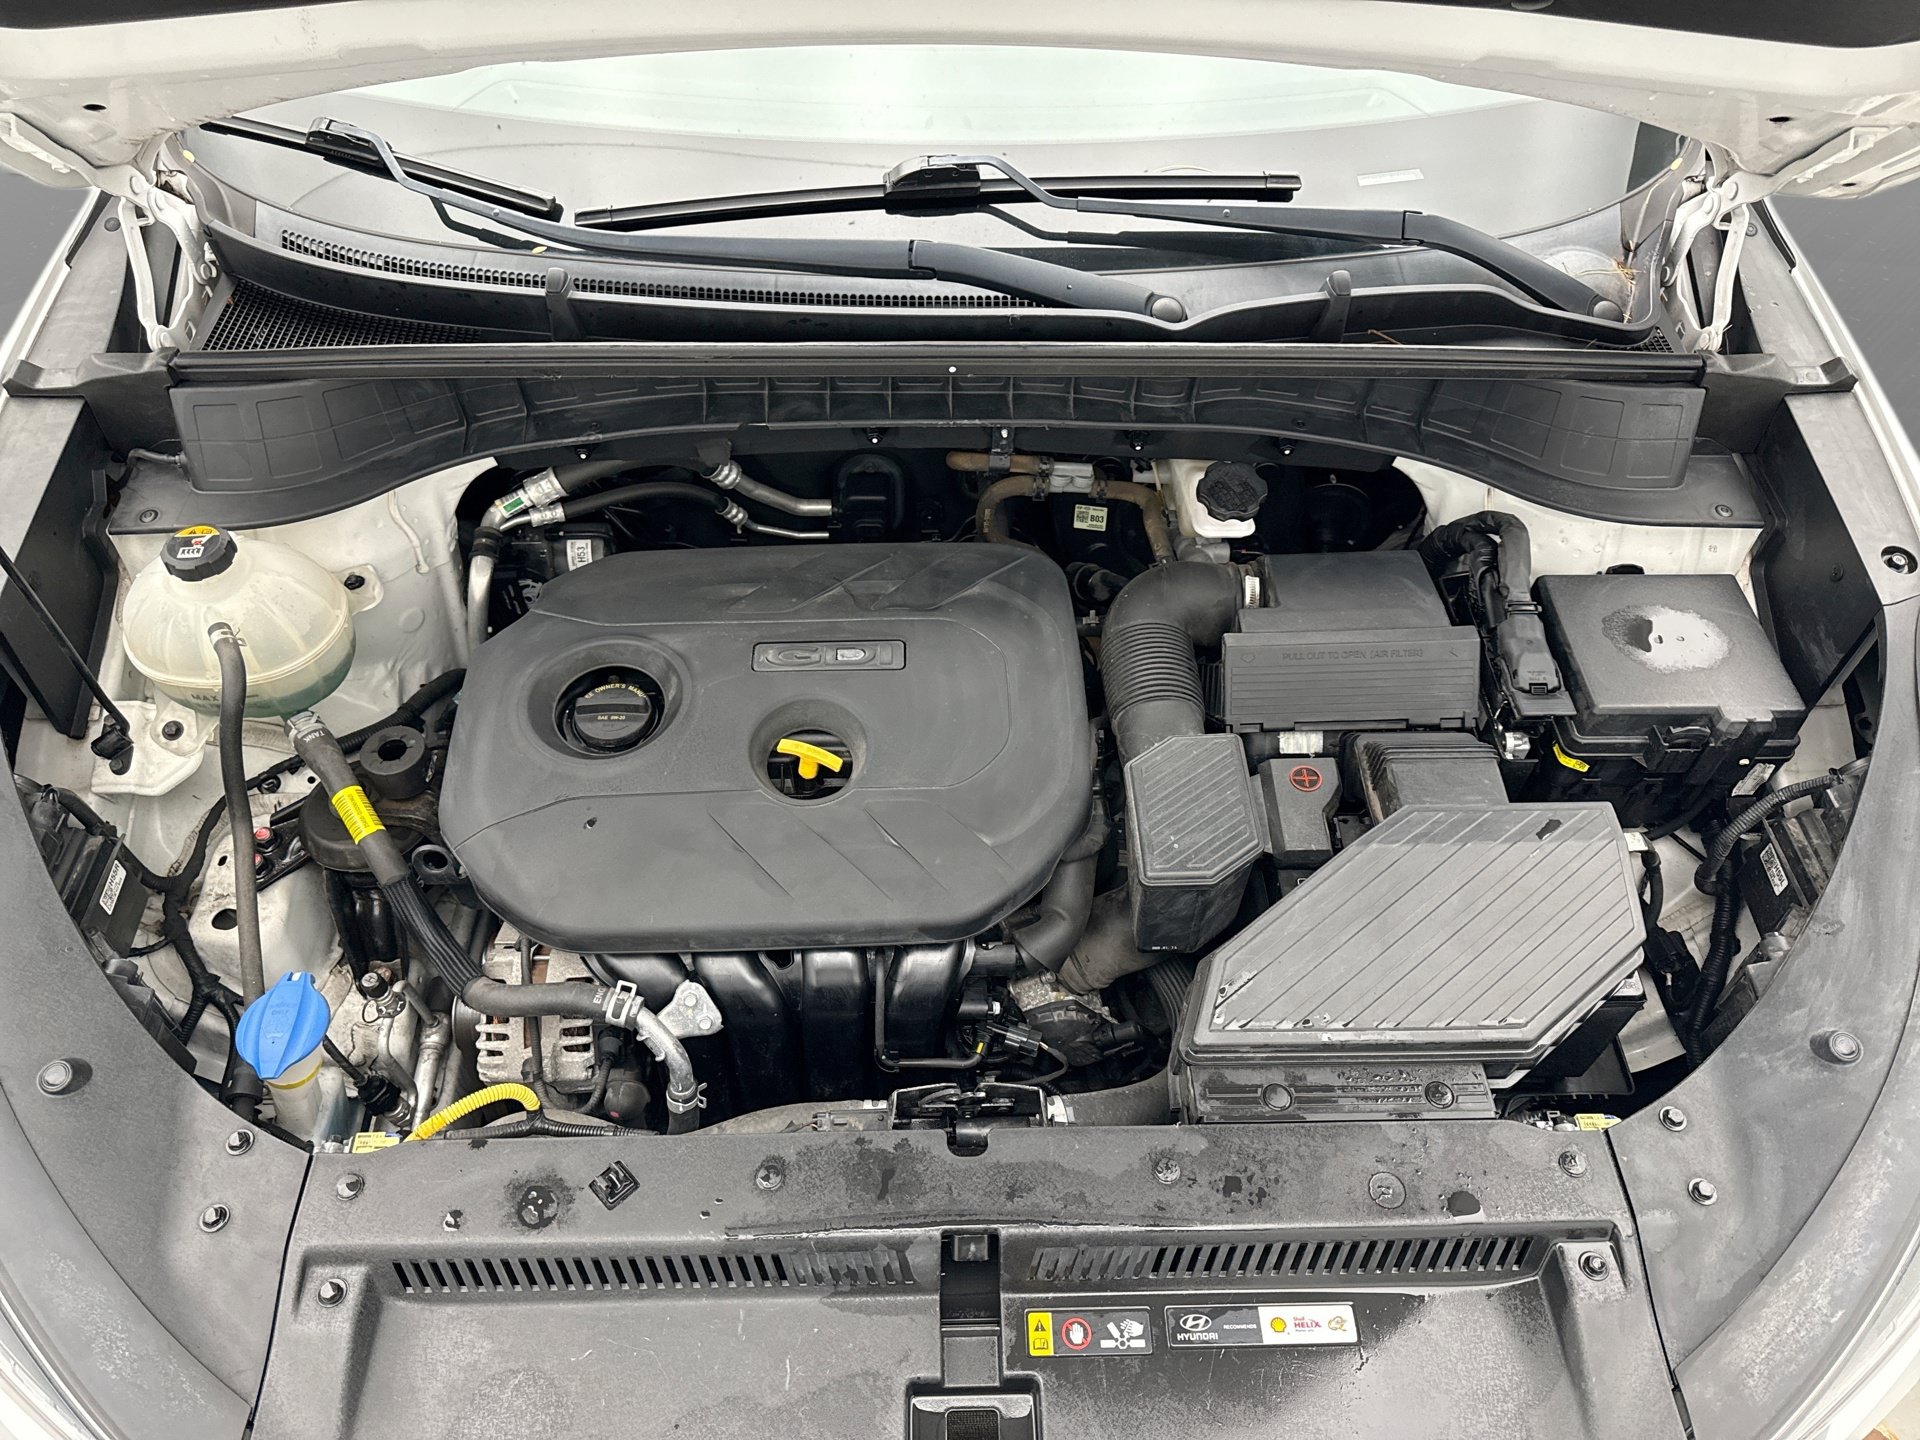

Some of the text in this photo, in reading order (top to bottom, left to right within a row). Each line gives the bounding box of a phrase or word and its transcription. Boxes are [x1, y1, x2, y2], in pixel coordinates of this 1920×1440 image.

[576, 546, 586, 562] H53
[1282, 652, 1305, 660] PULL
[1307, 651, 1325, 660] OUT
[1328, 651, 1339, 660] TO
[595, 683, 626, 693] OWNER'S
[628, 685, 647, 698] MANU
[191, 693, 220, 701] MAX
[1294, 1320, 1322, 1328] HELIX
[1177, 1332, 1218, 1341] HYUNDAI
